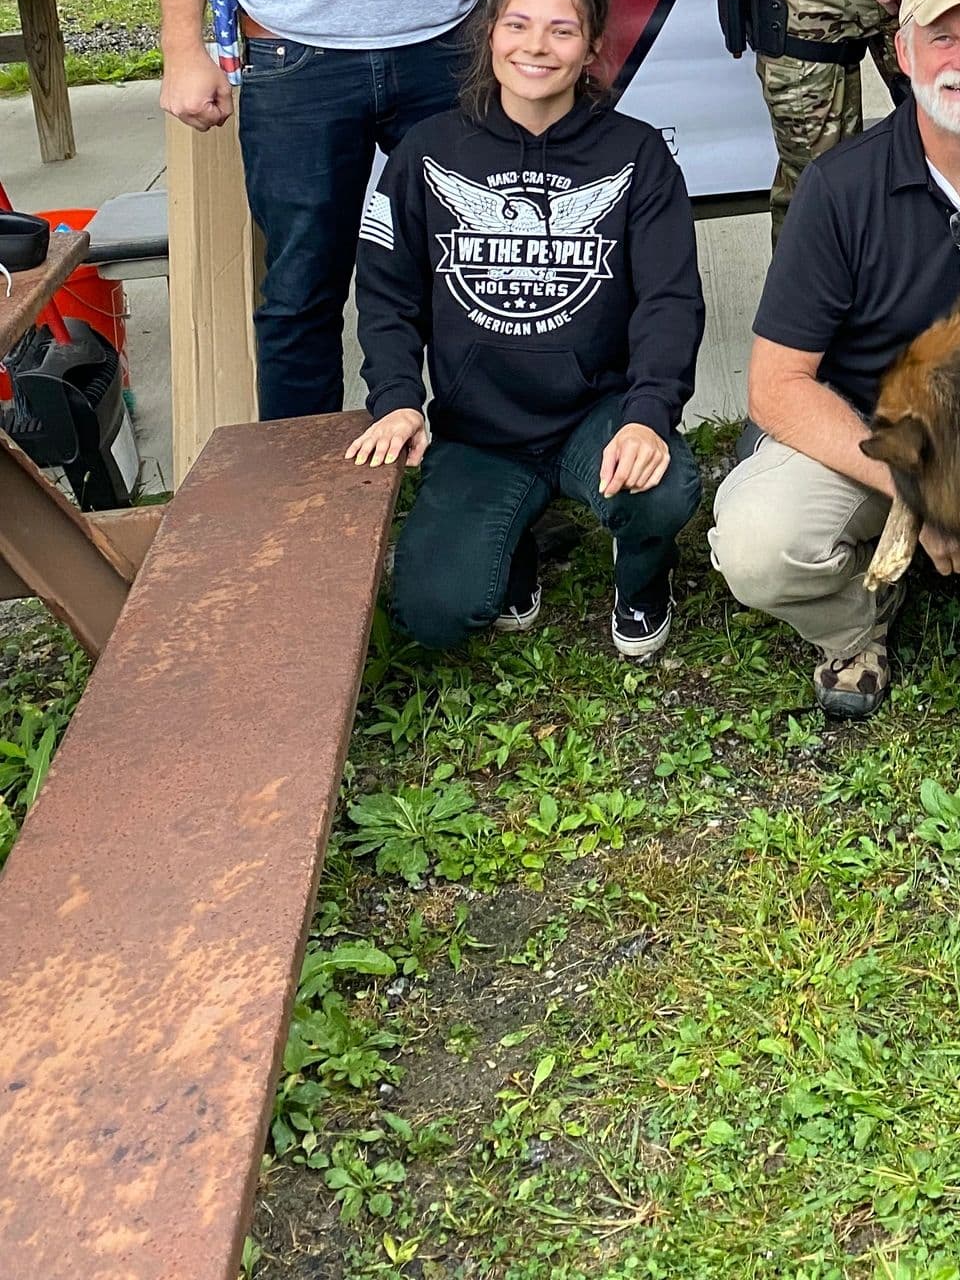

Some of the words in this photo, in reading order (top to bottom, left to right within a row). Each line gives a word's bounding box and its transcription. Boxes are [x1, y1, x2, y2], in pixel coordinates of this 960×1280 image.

[458, 237, 483, 263] WE
[488, 238, 522, 263] THE
[526, 239, 595, 266] PEOPLE
[475, 281, 568, 297] HOLSTERS
[467, 309, 531, 336] AMERICAN
[536, 310, 573, 335] MADE
